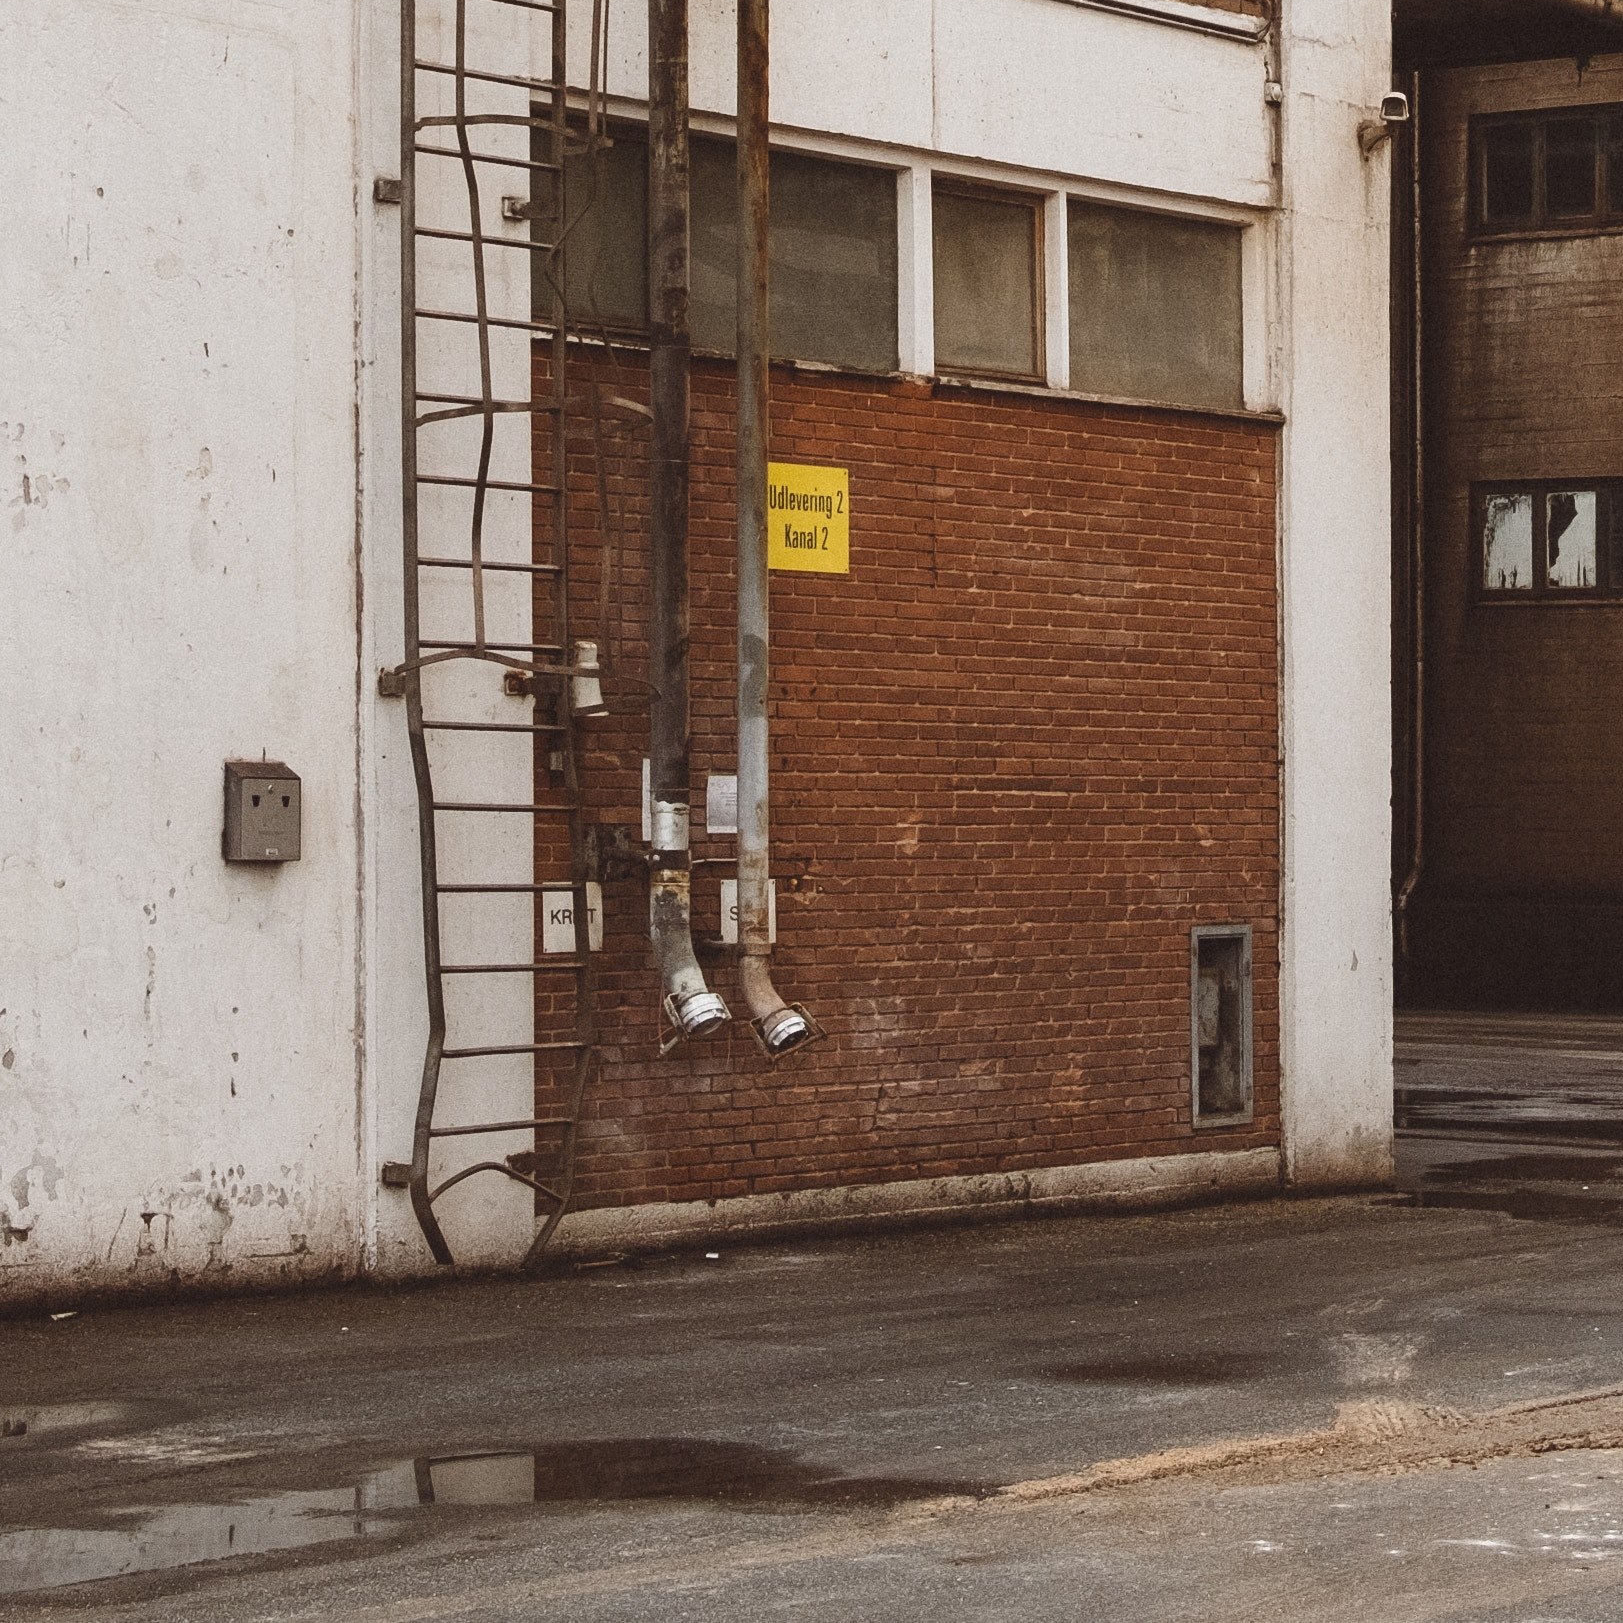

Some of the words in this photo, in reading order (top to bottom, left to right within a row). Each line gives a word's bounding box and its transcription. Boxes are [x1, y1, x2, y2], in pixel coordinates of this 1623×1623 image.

[769, 484, 833, 519] Udlevering
[836, 490, 844, 514] 2
[785, 523, 817, 549] Kanal
[821, 526, 828, 550] 2
